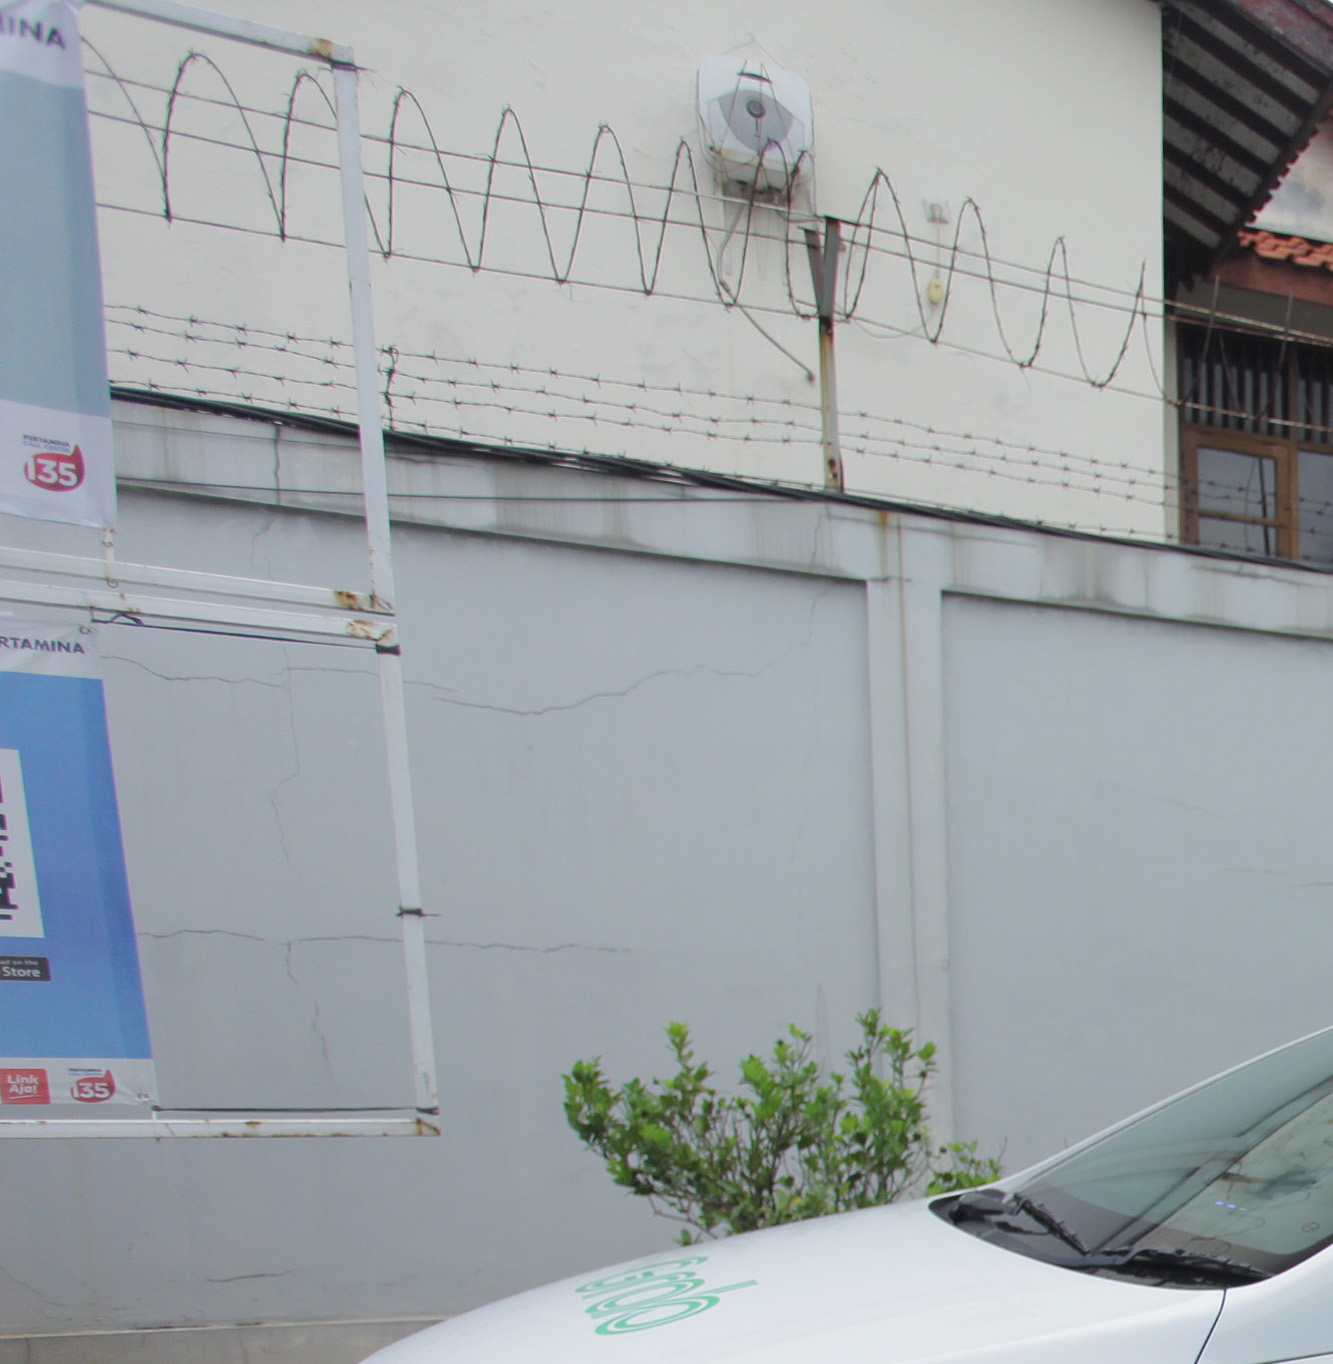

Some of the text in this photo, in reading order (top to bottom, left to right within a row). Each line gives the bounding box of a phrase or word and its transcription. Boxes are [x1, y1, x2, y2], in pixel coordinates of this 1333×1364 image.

[27, 456, 79, 487] 135
[2, 966, 41, 977] Store
[7, 1074, 39, 1085] Link
[72, 1081, 111, 1099] 135
